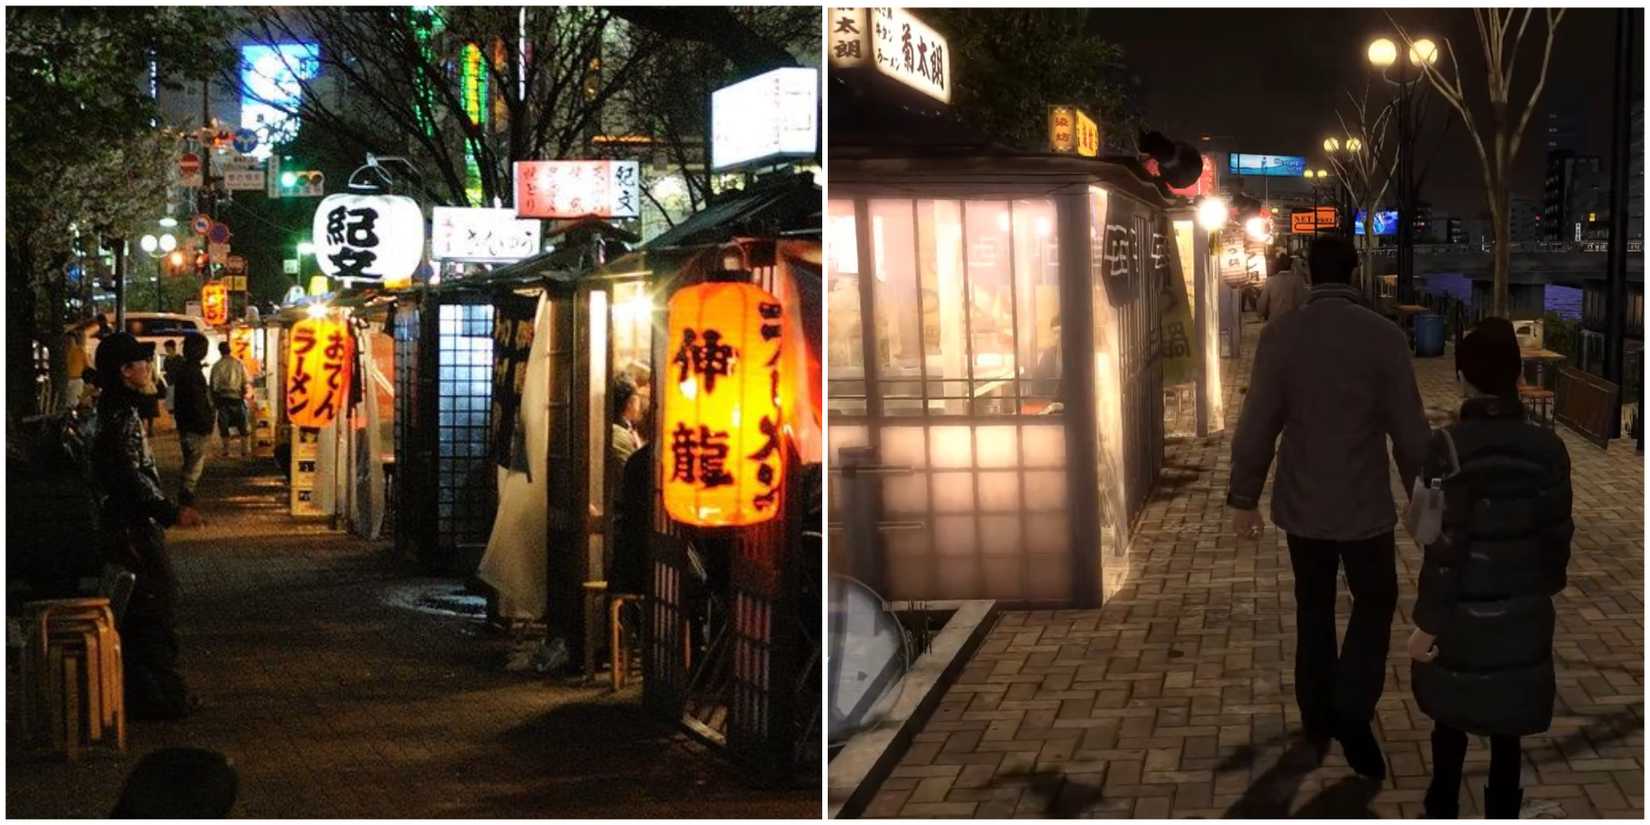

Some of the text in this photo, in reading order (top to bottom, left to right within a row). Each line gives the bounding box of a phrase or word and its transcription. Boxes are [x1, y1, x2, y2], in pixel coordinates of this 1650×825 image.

[833, 8, 861, 59] 太朗
[326, 205, 384, 279] 紀文
[288, 328, 318, 415] ラーメン
[671, 328, 741, 488] 伸龍
